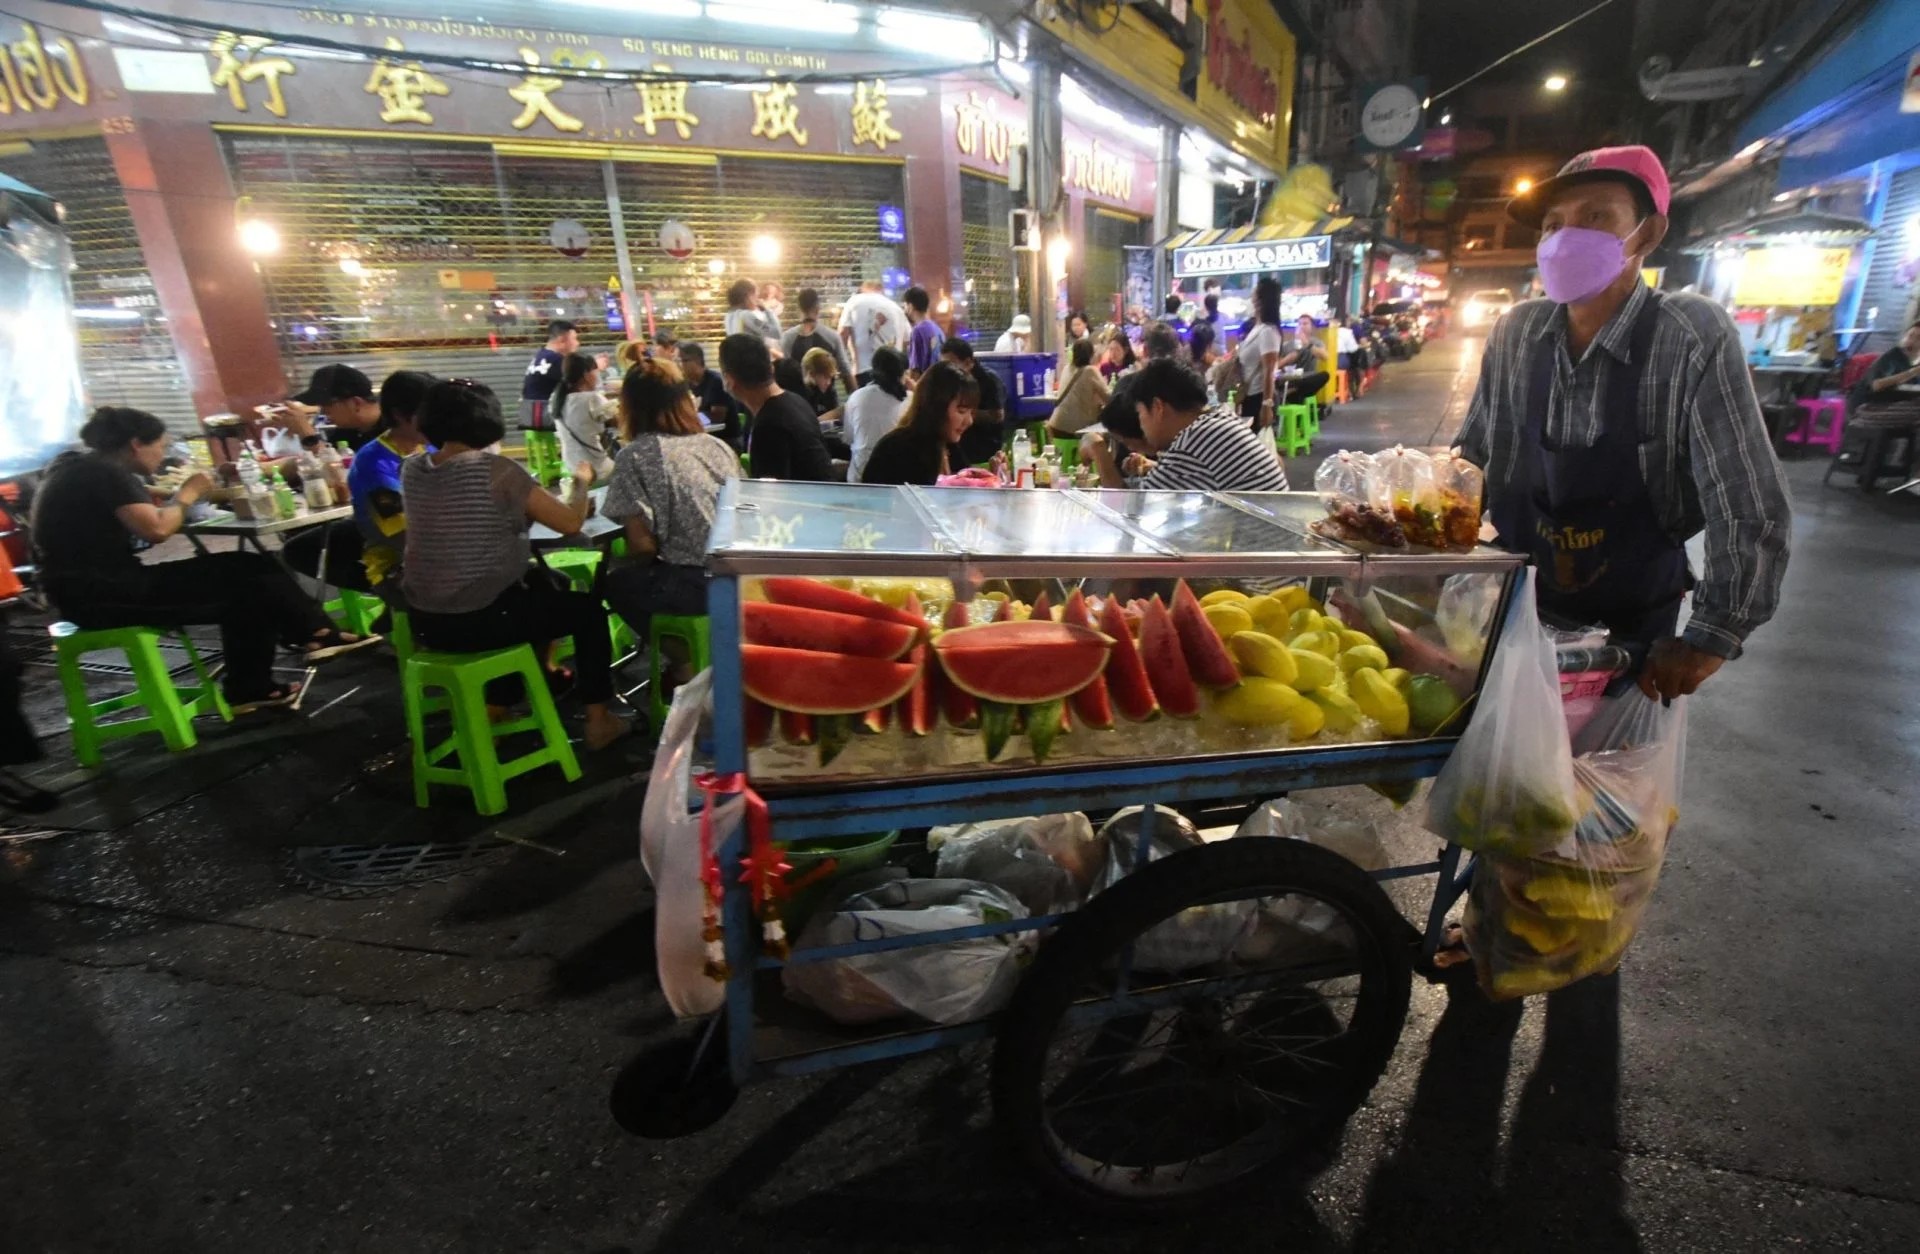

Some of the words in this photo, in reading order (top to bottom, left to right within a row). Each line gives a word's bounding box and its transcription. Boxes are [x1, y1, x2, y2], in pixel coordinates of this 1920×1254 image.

[622, 37, 645, 54] SO
[651, 40, 693, 58] SENG
[698, 45, 739, 62] HENG
[745, 49, 826, 70] GOLDSMITH
[1183, 247, 1259, 272] OYSTER
[1275, 242, 1318, 266] BAR
